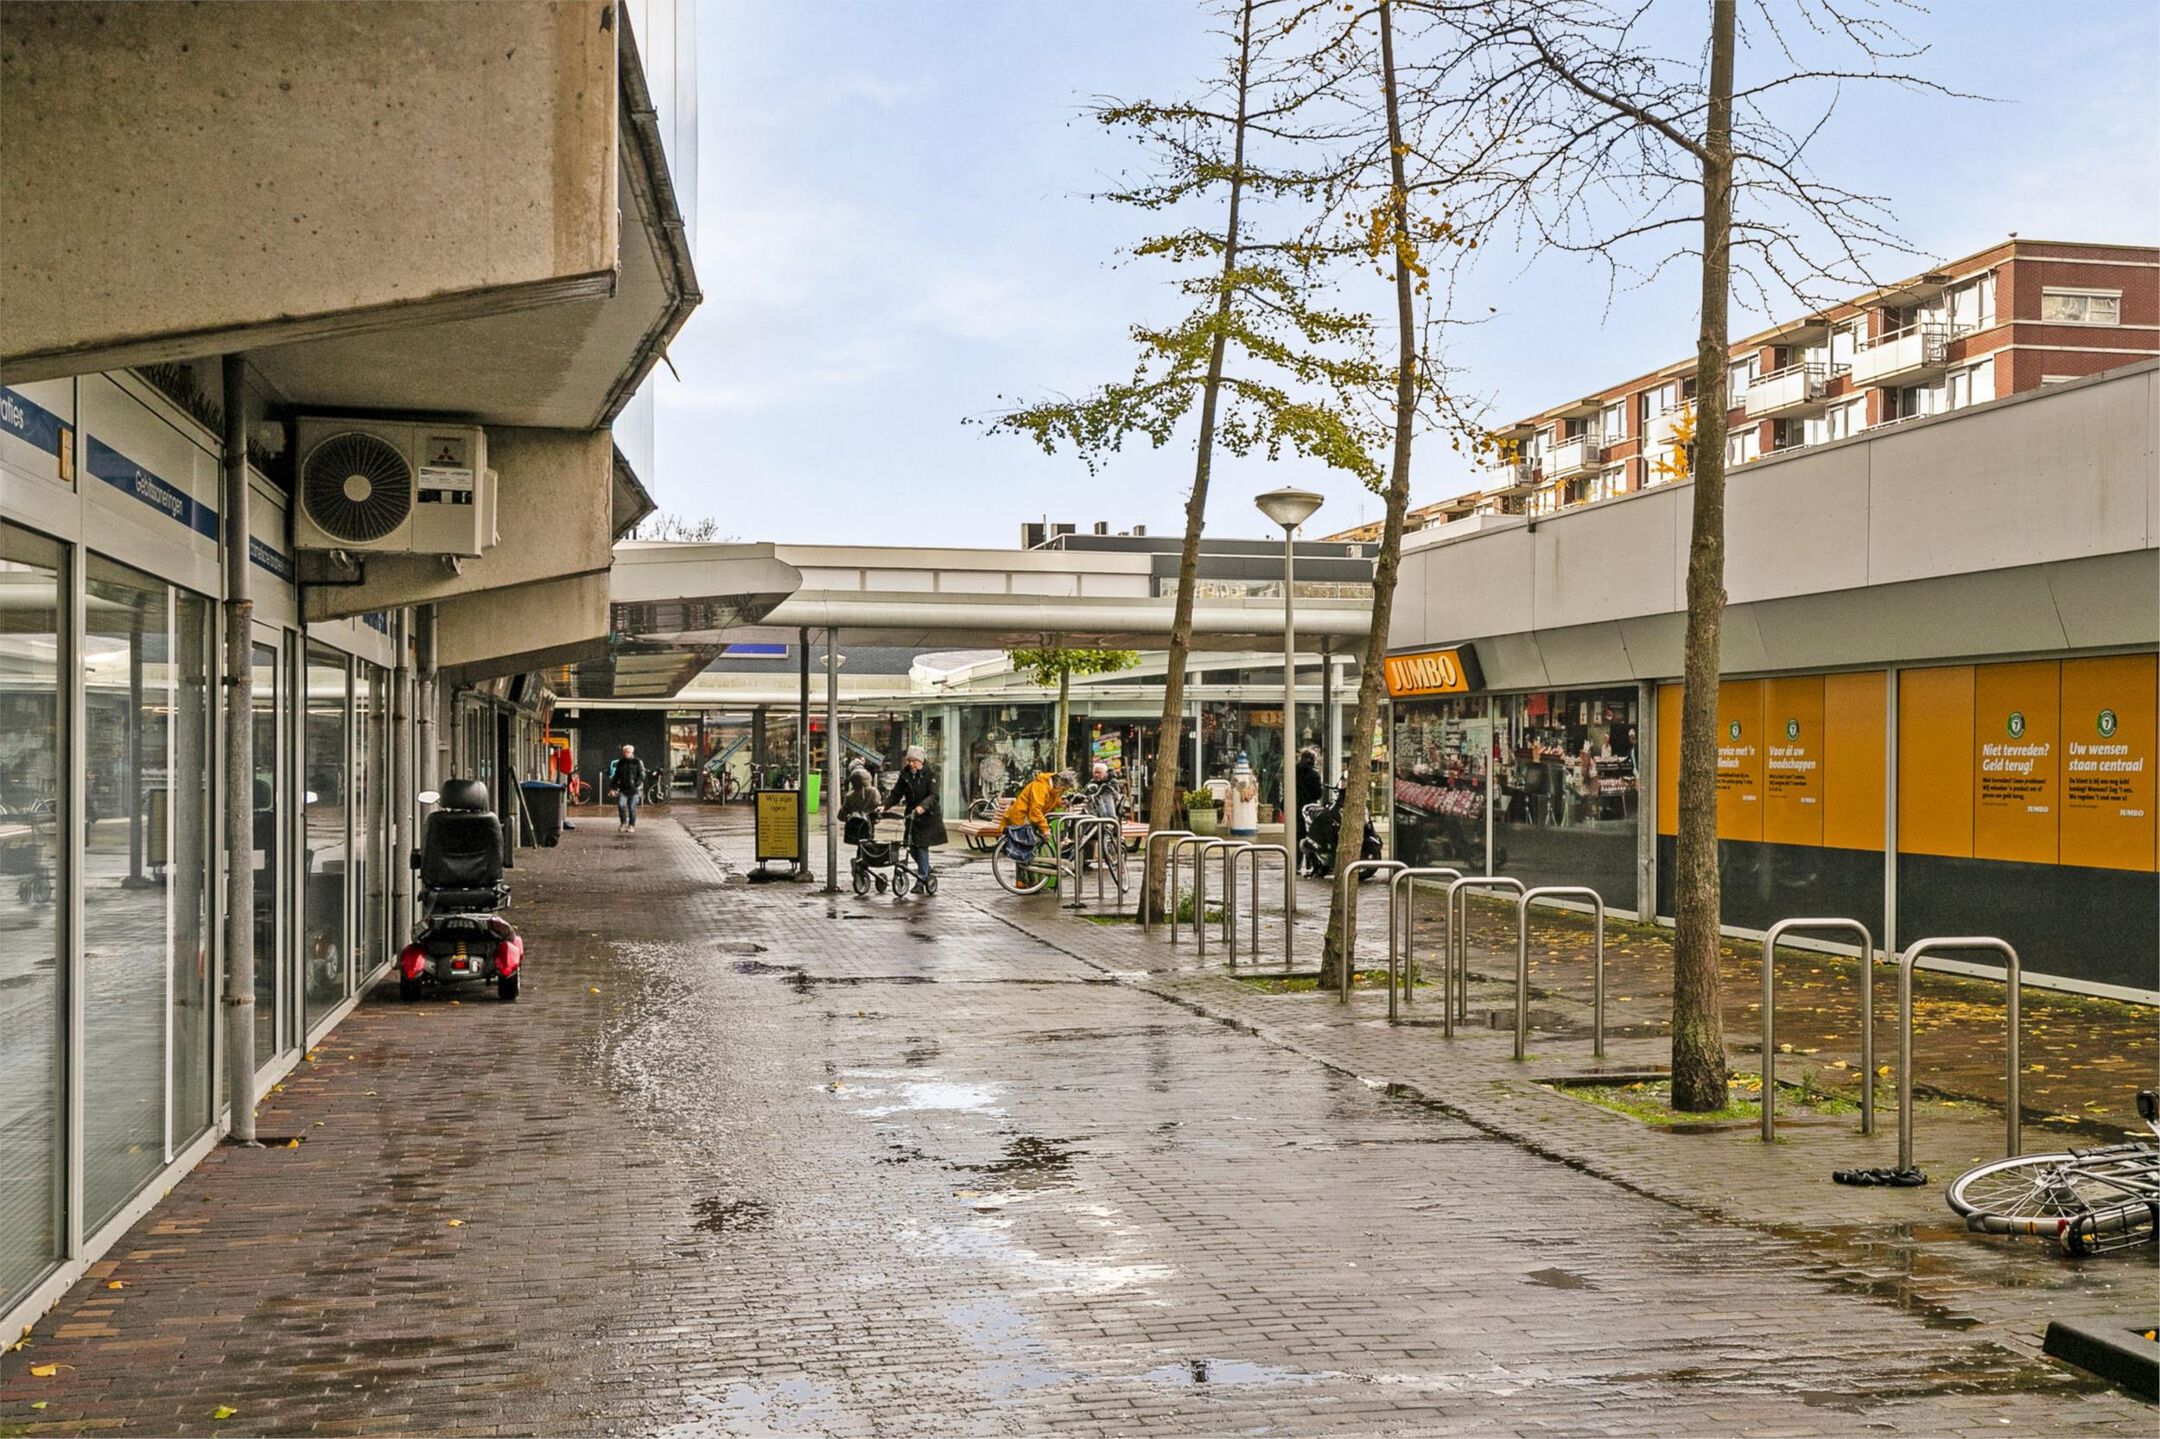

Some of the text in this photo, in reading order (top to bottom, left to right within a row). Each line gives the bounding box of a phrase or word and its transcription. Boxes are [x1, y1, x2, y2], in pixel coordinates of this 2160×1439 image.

[0, 396, 25, 430] aties
[1390, 655, 1457, 691] JUMBO
[1718, 745, 1735, 755] ervice
[1735, 746, 1748, 756] met
[1769, 746, 1785, 756] Voor
[1794, 747, 1805, 756] uw
[1982, 743, 2050, 756] Niet tevreden?
[2069, 742, 2128, 755] Uw wensen
[1768, 758, 1816, 771] boodschappen
[1982, 758, 2034, 775] Geld terug!
[2068, 758, 2143, 772] staan centraal
[2027, 805, 2049, 814] JUMBO
[2119, 809, 2144, 817] JUMBO
